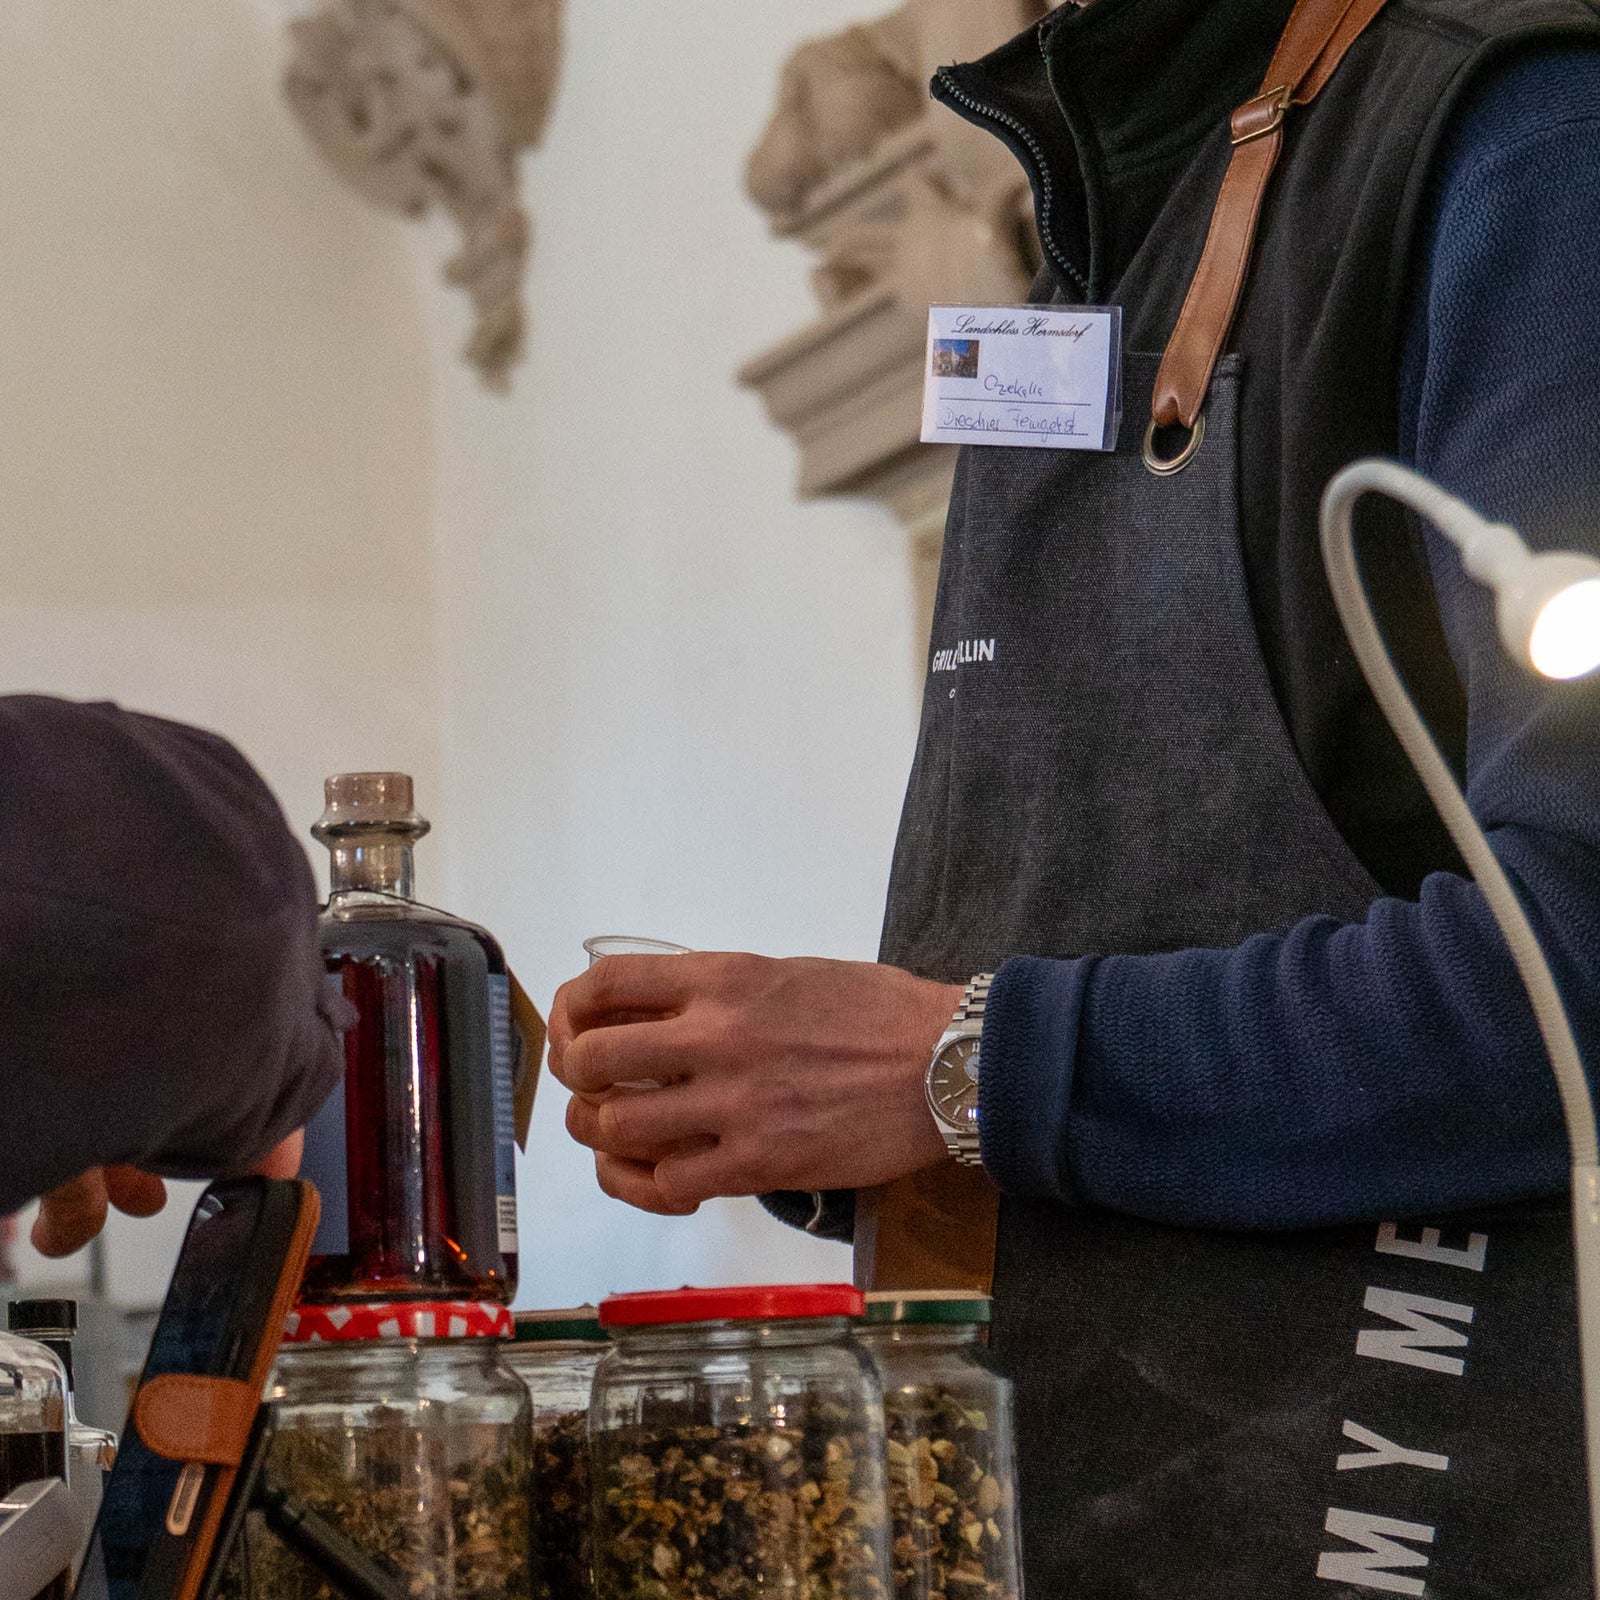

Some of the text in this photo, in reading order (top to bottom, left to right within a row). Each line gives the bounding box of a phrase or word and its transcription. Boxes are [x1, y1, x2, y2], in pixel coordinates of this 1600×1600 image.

[952, 315, 1093, 343] Landschloss Hermsdorf
[1316, 1418, 1449, 1598] MY
